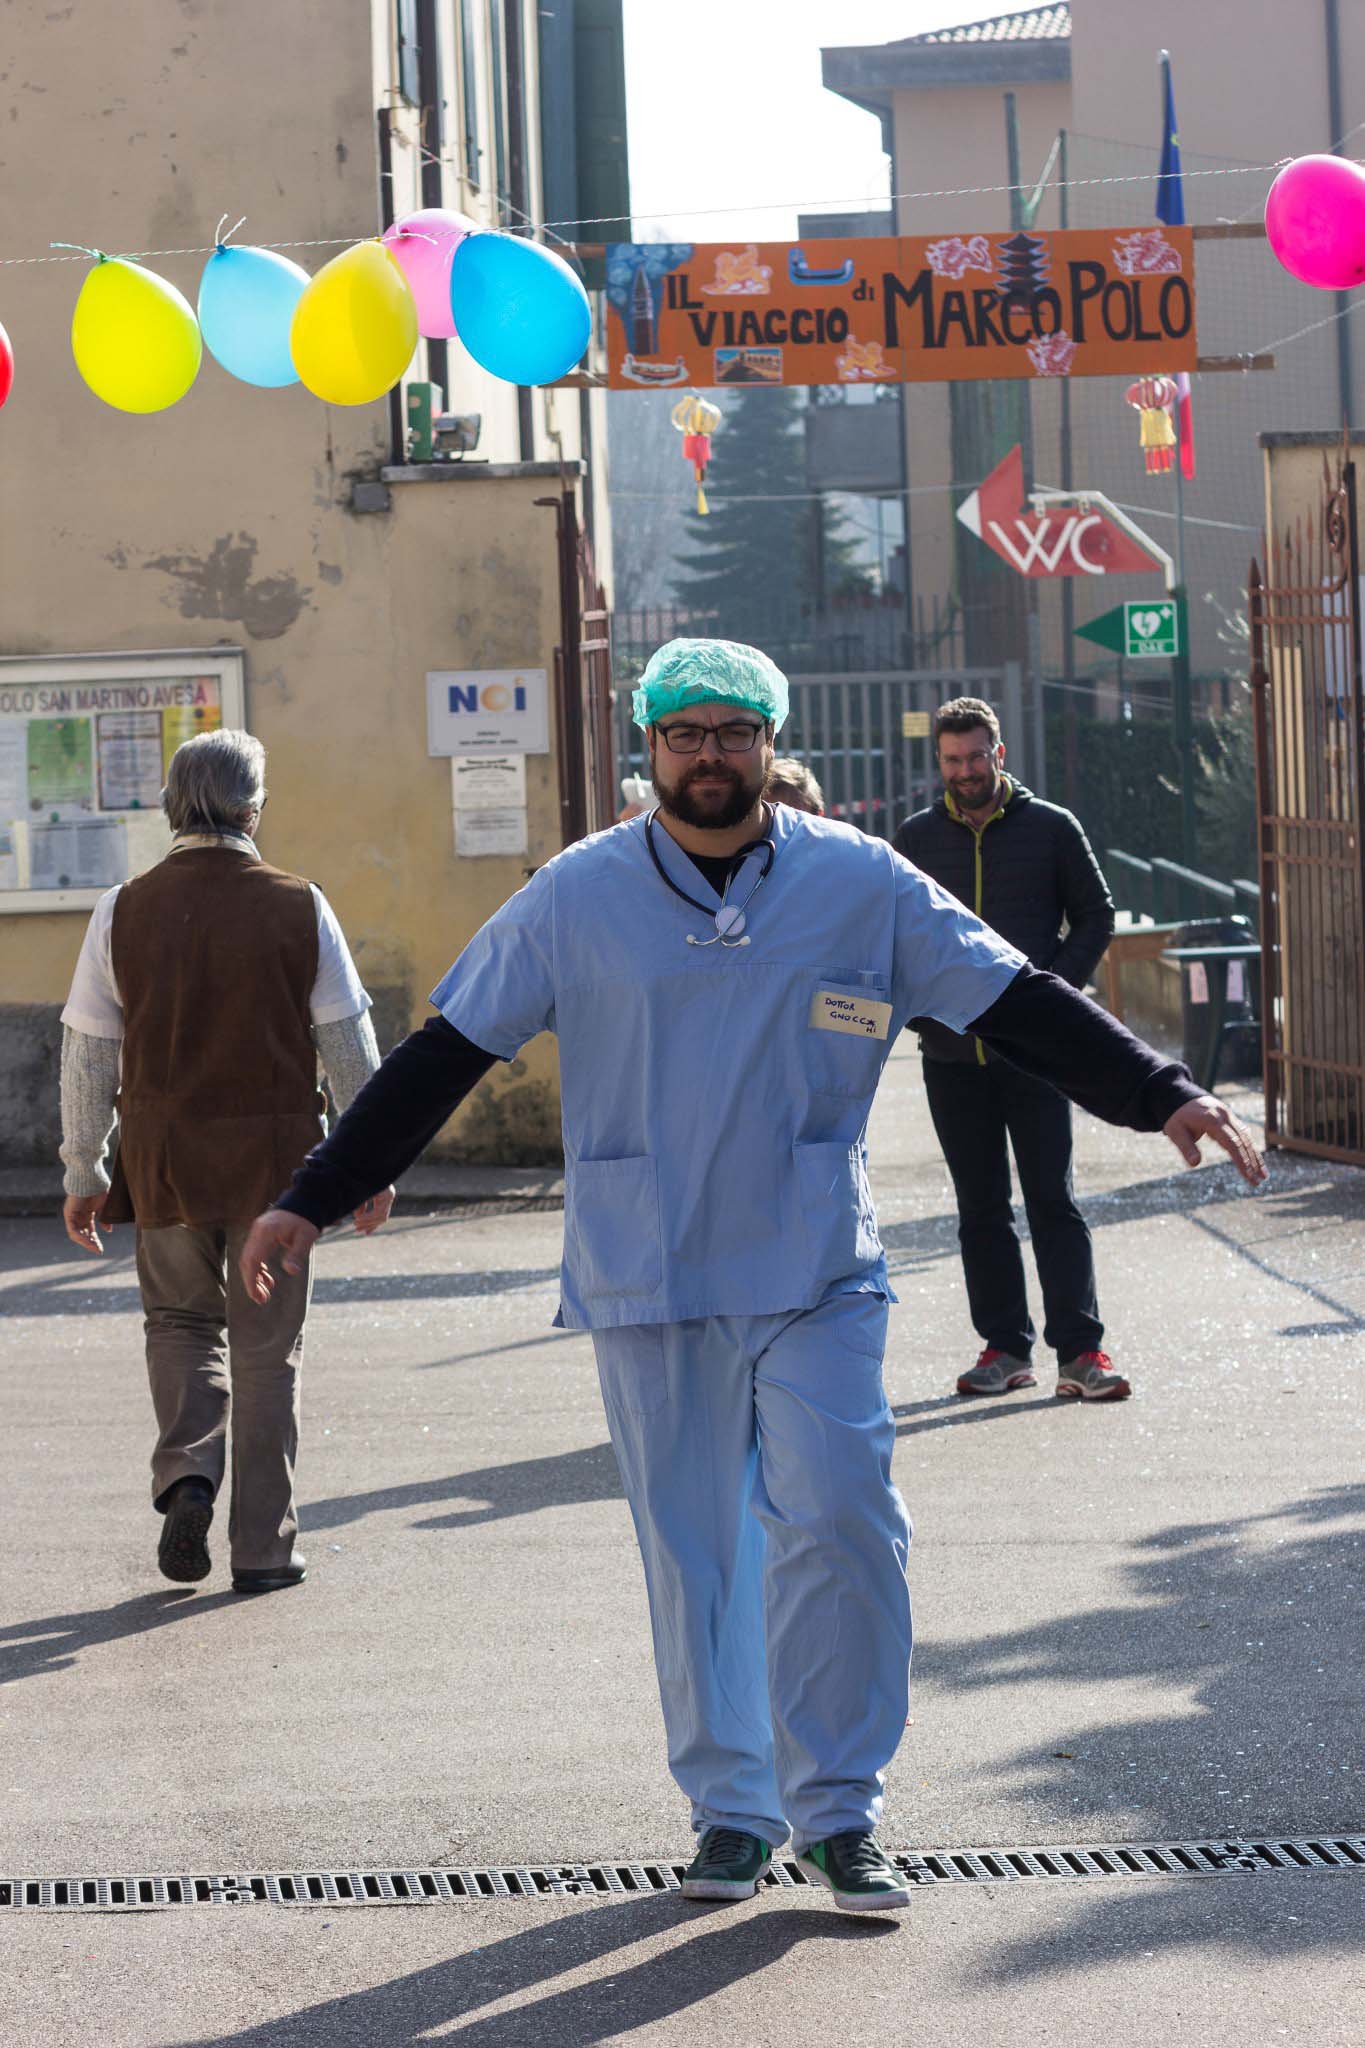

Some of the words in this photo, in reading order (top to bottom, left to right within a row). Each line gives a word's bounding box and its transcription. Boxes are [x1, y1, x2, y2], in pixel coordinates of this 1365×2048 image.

[666, 274, 704, 310] IL
[852, 277, 875, 302] di
[882, 269, 1062, 348] MARCO
[1067, 260, 1192, 343] POLO
[688, 307, 849, 347] VIAGGIO
[987, 515, 1105, 575] WC
[38, 689, 71, 712] SAN
[75, 686, 149, 709] MARTINO
[152, 683, 208, 706] AVESA
[825, 997, 855, 1011] DOTTOR
